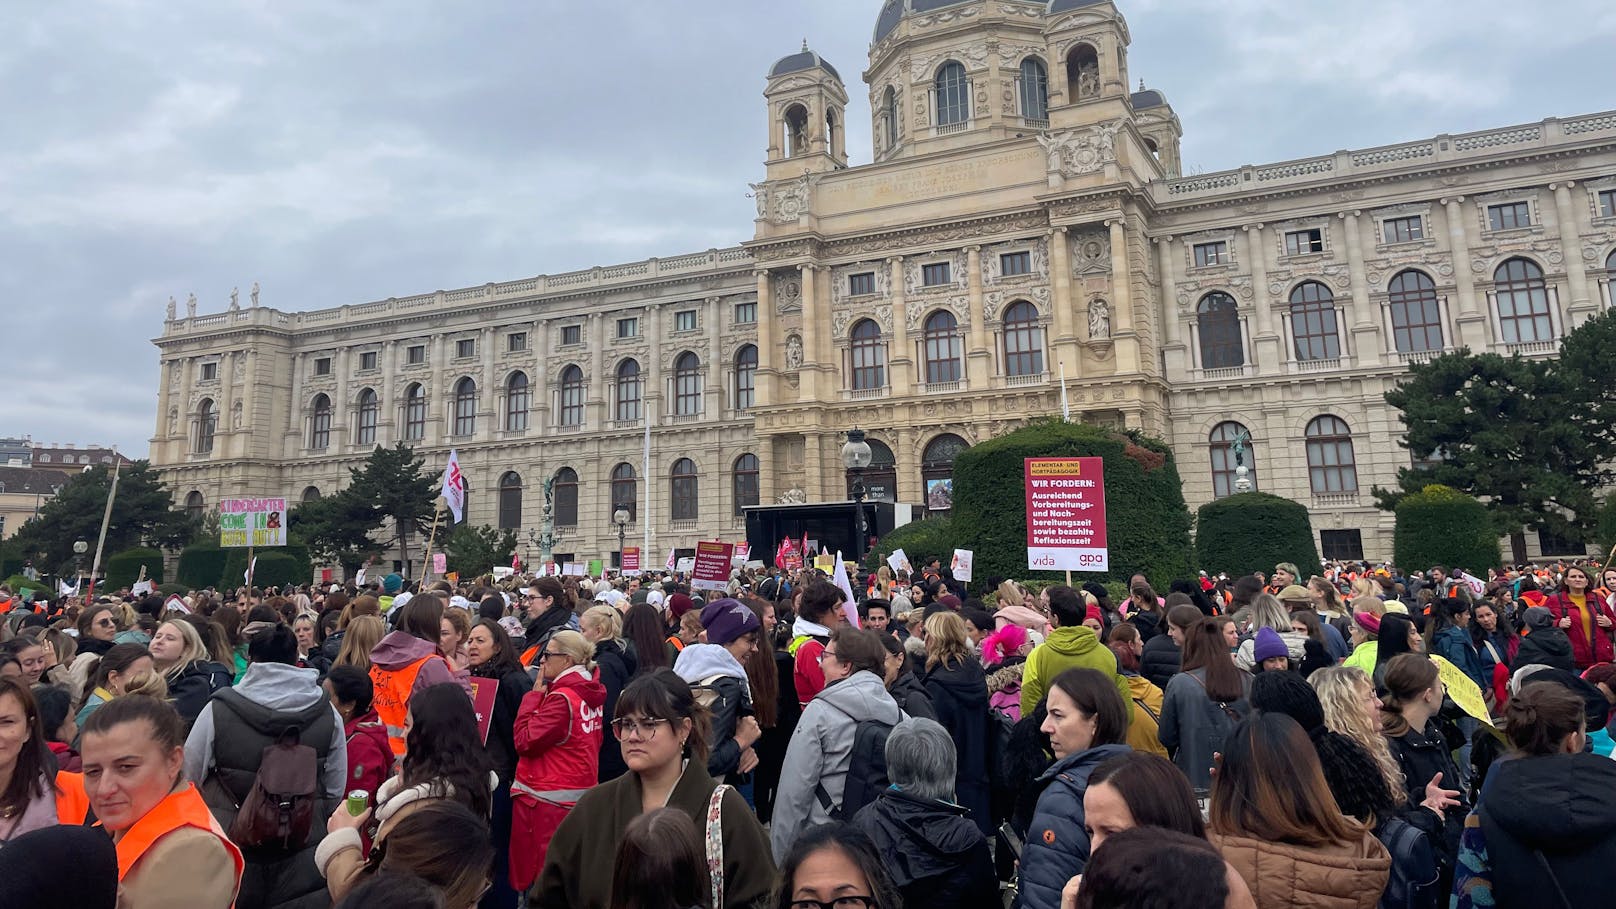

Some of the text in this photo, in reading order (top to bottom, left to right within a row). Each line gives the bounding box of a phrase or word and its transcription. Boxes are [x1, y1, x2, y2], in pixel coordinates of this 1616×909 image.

[220, 499, 284, 512] KINDERGARTEN
[1032, 501, 1094, 510] Vorbereitungs-
[221, 512, 266, 528] COME IN
[1033, 519, 1092, 528] bereitungszeit
[221, 528, 279, 545] BURN OUT!
[1033, 555, 1055, 566] vida
[1080, 554, 1102, 566] gpa
